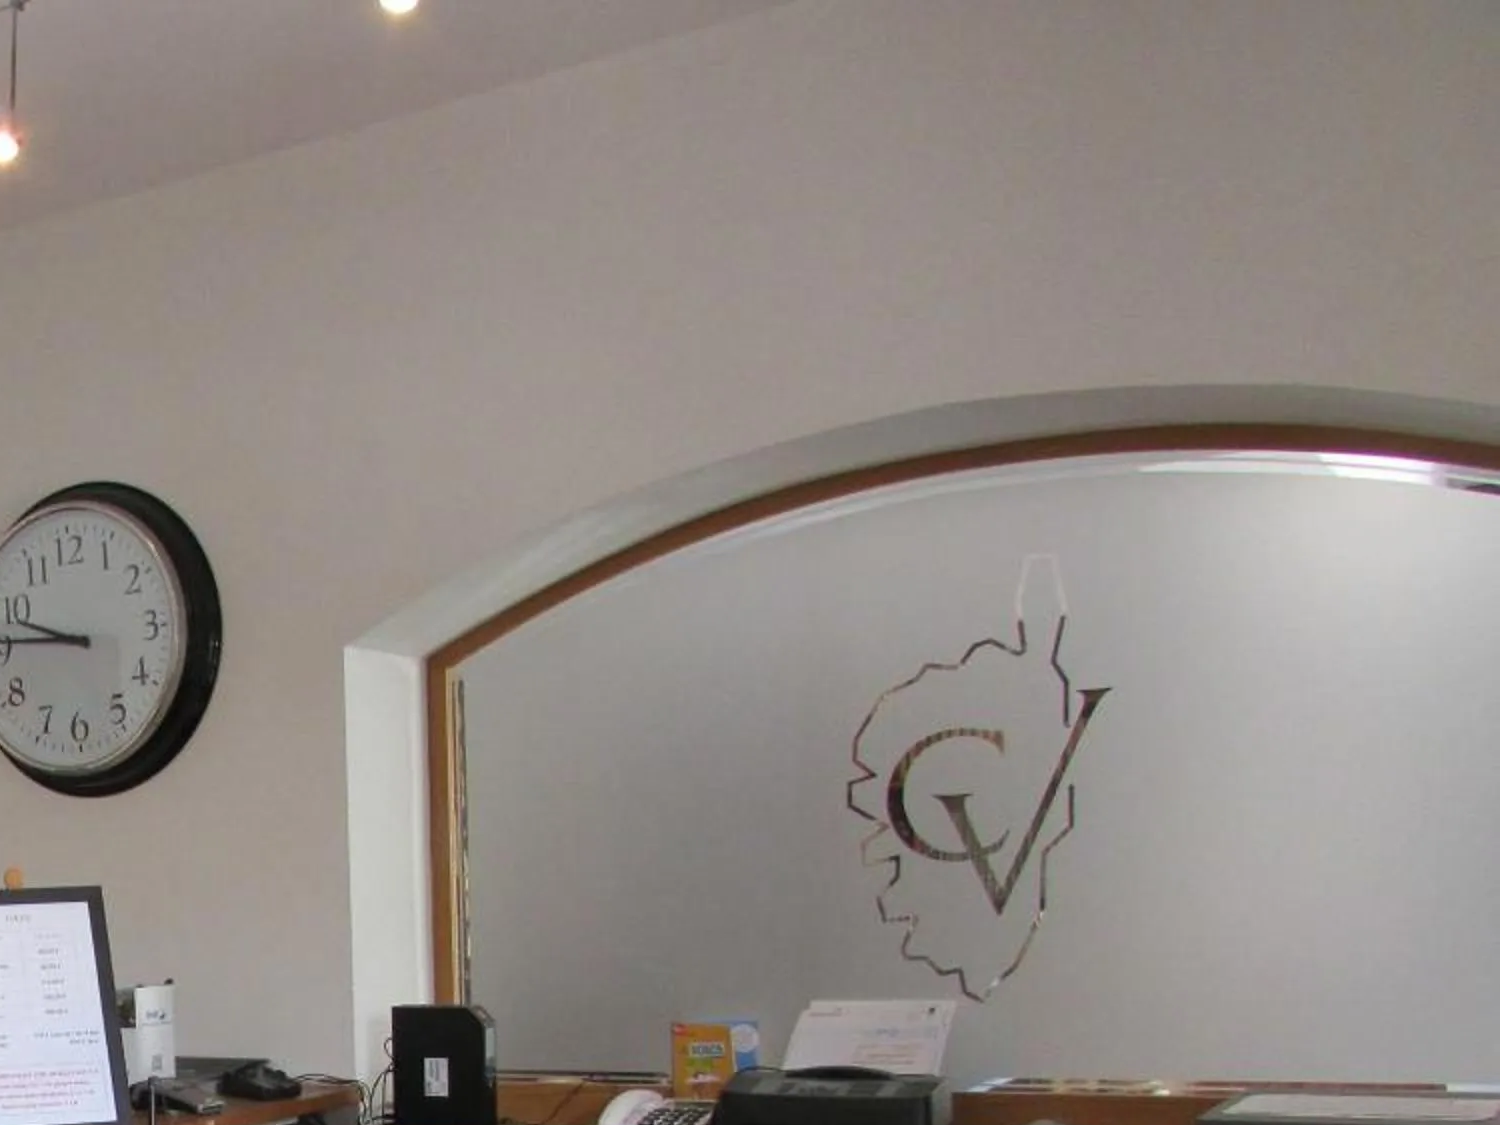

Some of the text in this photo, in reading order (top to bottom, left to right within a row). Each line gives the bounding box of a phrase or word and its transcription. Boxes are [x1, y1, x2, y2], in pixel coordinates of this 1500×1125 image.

[54, 534, 85, 567] 12
[101, 539, 111, 571] 1
[25, 555, 48, 588] 11
[123, 563, 143, 596] 2
[3, 593, 32, 626] 10
[143, 609, 160, 642] 3
[131, 655, 150, 686] 4
[7, 676, 27, 708] 8
[37, 704, 54, 735] 7
[108, 692, 128, 726] 5
[69, 710, 90, 743] 6
